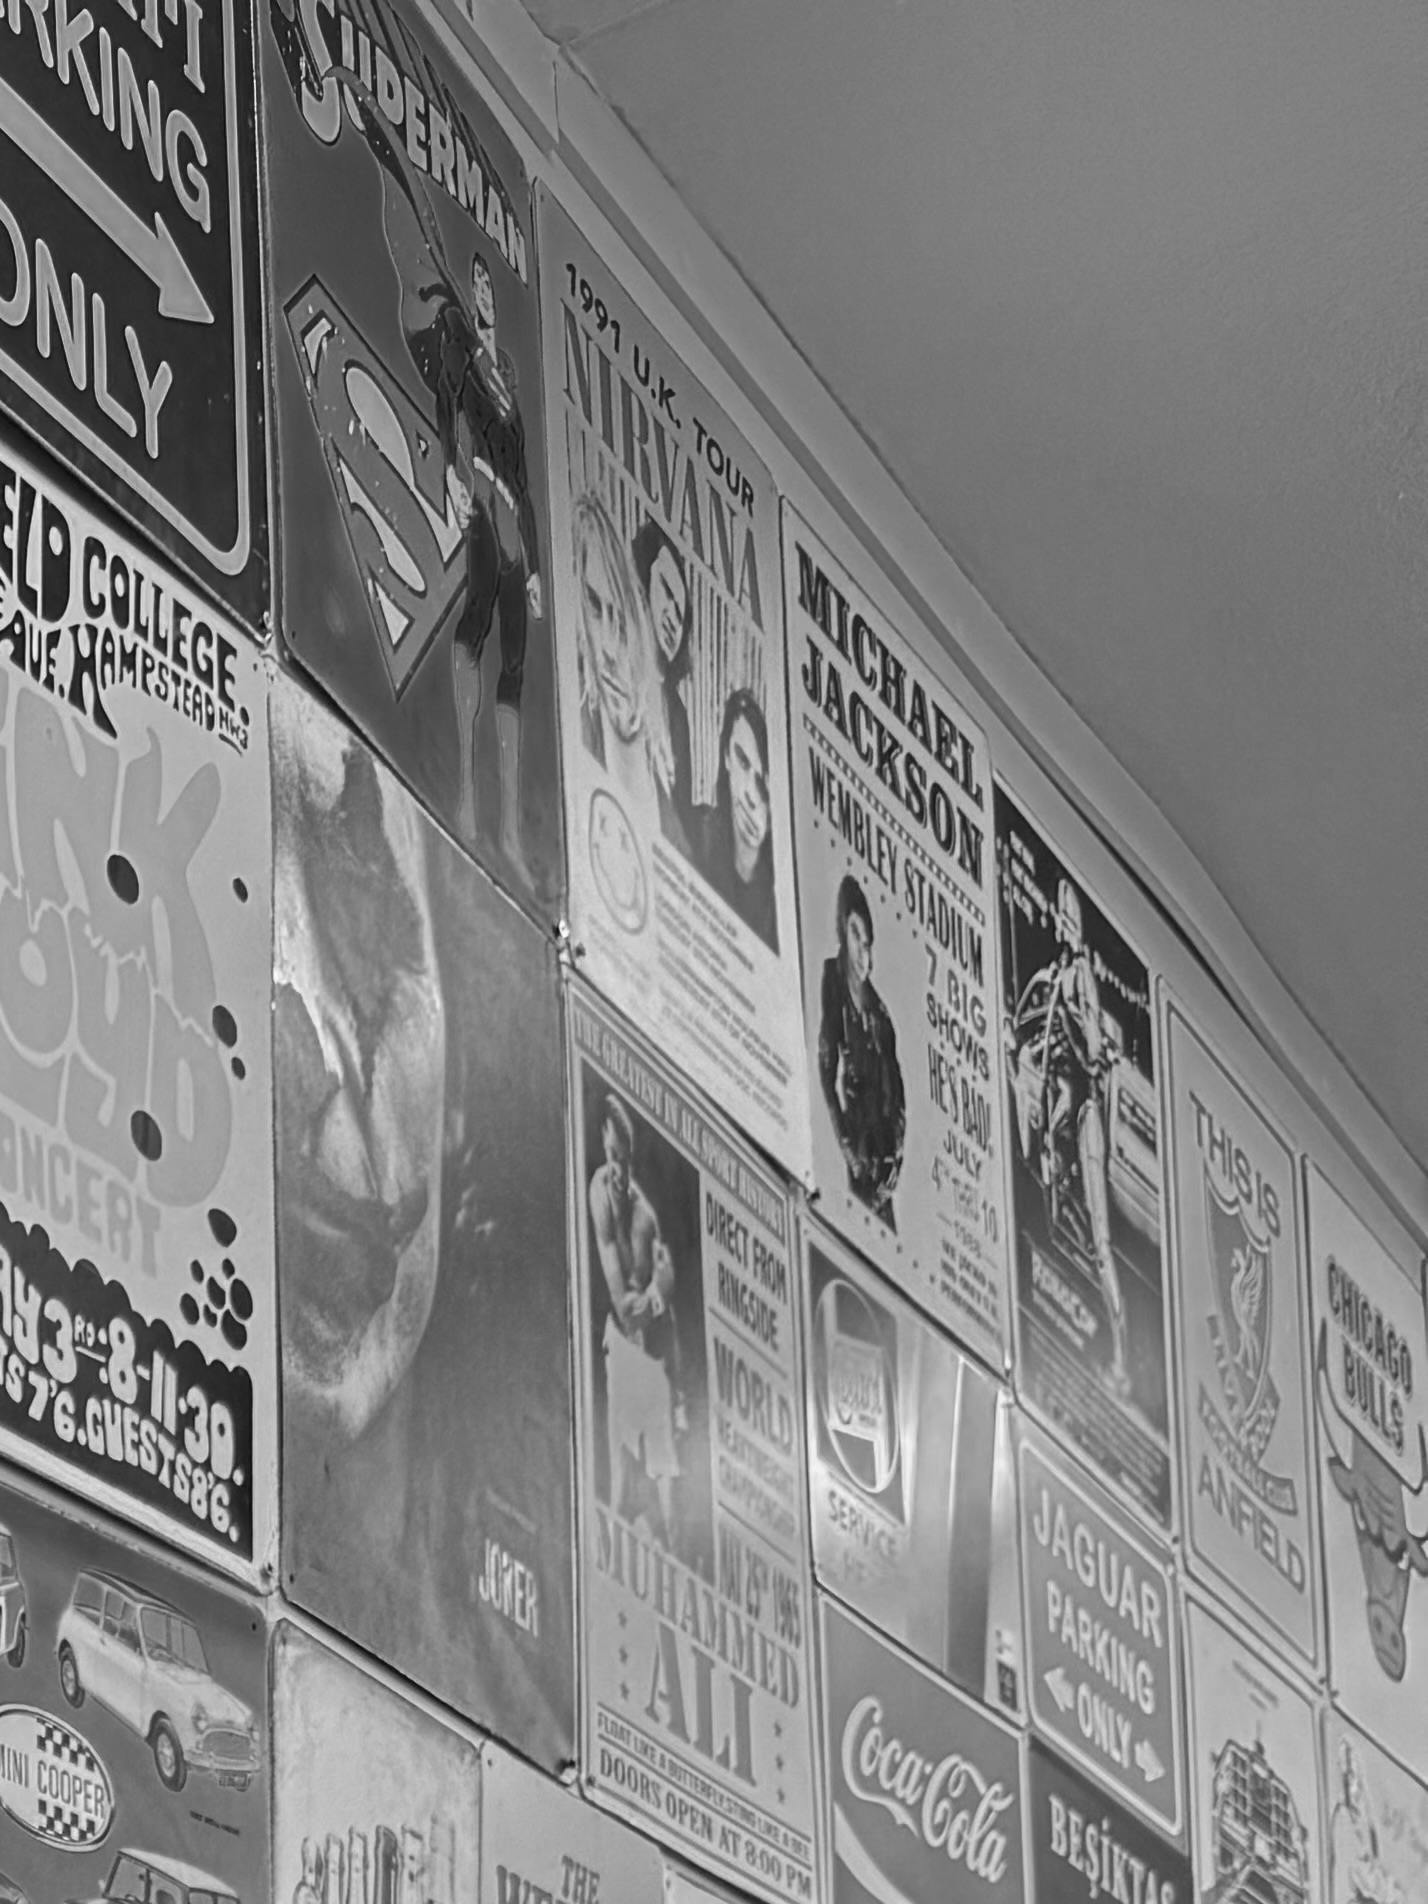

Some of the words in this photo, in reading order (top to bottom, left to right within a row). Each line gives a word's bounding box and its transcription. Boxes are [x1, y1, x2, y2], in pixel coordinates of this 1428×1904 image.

[565, 262, 620, 354] 1991
[633, 344, 681, 430] U.K.
[693, 417, 755, 518] TOUR
[562, 298, 765, 634] NIRVANA
[796, 540, 984, 810] MICHAEL
[802, 633, 985, 890] JACKSON
[808, 746, 898, 895] WEMBLEY
[905, 858, 984, 988] STADIUM
[926, 993, 990, 1082] SHOWS
[948, 969, 986, 1037] BIG
[944, 1130, 982, 1181] JULY
[1189, 1090, 1254, 1210] THIS
[705, 1192, 748, 1269] DIRECT
[752, 1228, 787, 1304] FROM
[717, 1262, 779, 1352] RINGSIDE
[1327, 1254, 1413, 1400] CHICAGO
[1033, 1488, 1163, 1649] JAGUAR
[1199, 1455, 1305, 1594] ANFIELD
[1046, 1580, 1154, 1715] PARKING
[36, 1761, 105, 1816] COOPER
[844, 1696, 1014, 1884] Coca-Cola
[1078, 1680, 1132, 1768] ONLY
[600, 1748, 662, 1808] DOORS
[666, 1791, 713, 1842] OPEN
[719, 1825, 741, 1858] AT
[786, 1863, 811, 1898] PM
